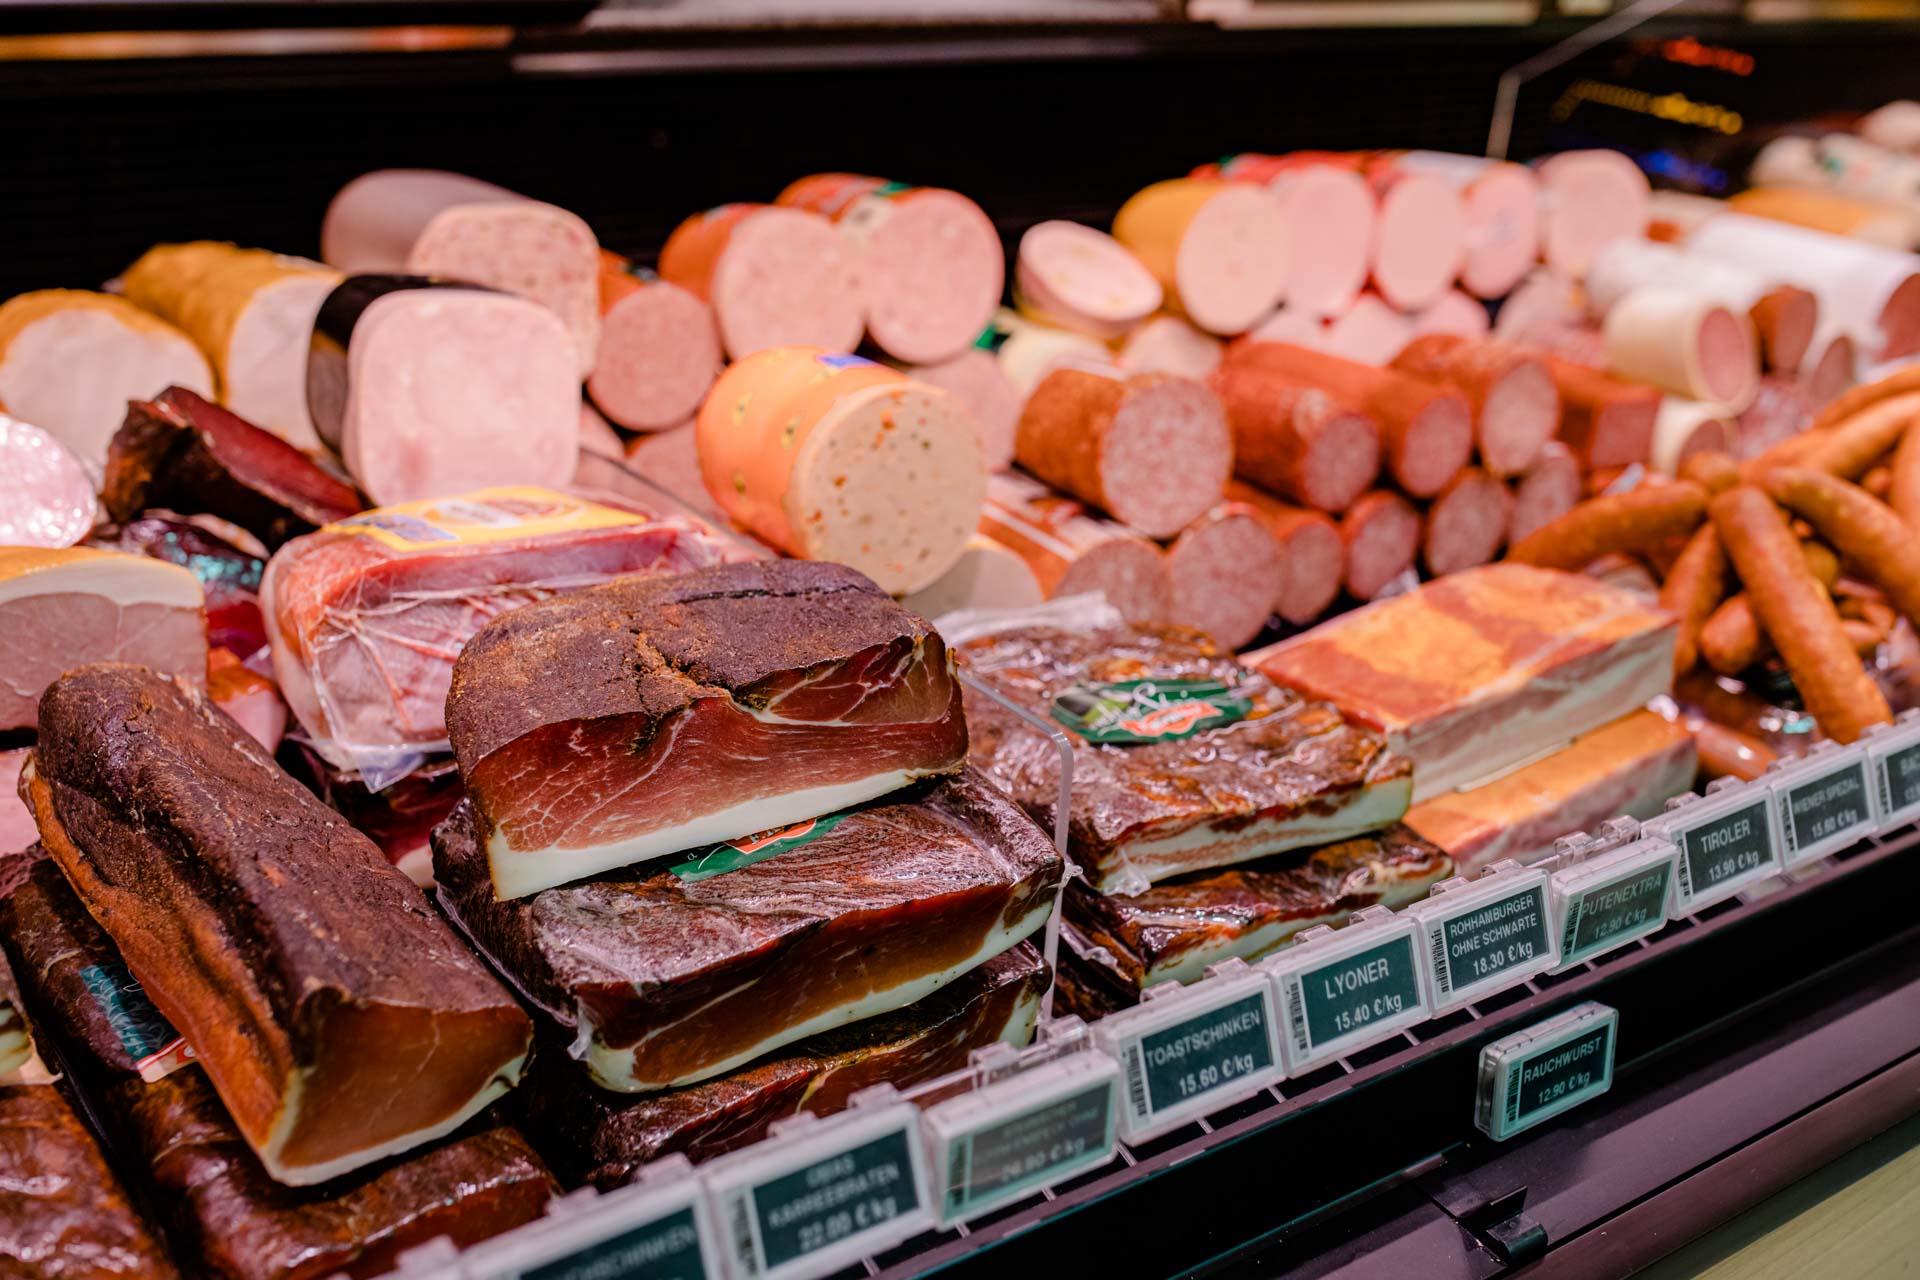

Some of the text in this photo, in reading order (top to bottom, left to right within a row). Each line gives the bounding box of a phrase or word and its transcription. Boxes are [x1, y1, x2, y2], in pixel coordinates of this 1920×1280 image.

[1701, 819, 1750, 853] TIROLER
[1709, 851, 1760, 881] 13.90 €/kg
[1450, 895, 1534, 938] ROHHAMBURGER
[1581, 874, 1662, 920] PUTENEXTRA
[1452, 935, 1481, 958] OHNE
[1482, 913, 1537, 945] SCHWARTE
[1595, 908, 1647, 939] 12.90 €/kg
[1324, 958, 1390, 1000] LYONER
[1473, 941, 1534, 976] 18.30 €/kg
[1334, 994, 1403, 1032] 15.40 €/kg
[1146, 1009, 1260, 1068] TOASTSCHINKEN
[1179, 1053, 1254, 1096] 15.60 €/kg
[1524, 1036, 1602, 1084] RAUCHWURST
[1538, 1072, 1591, 1105] 12.90 €/kg
[768, 1161, 900, 1230] KARREEBRATEN
